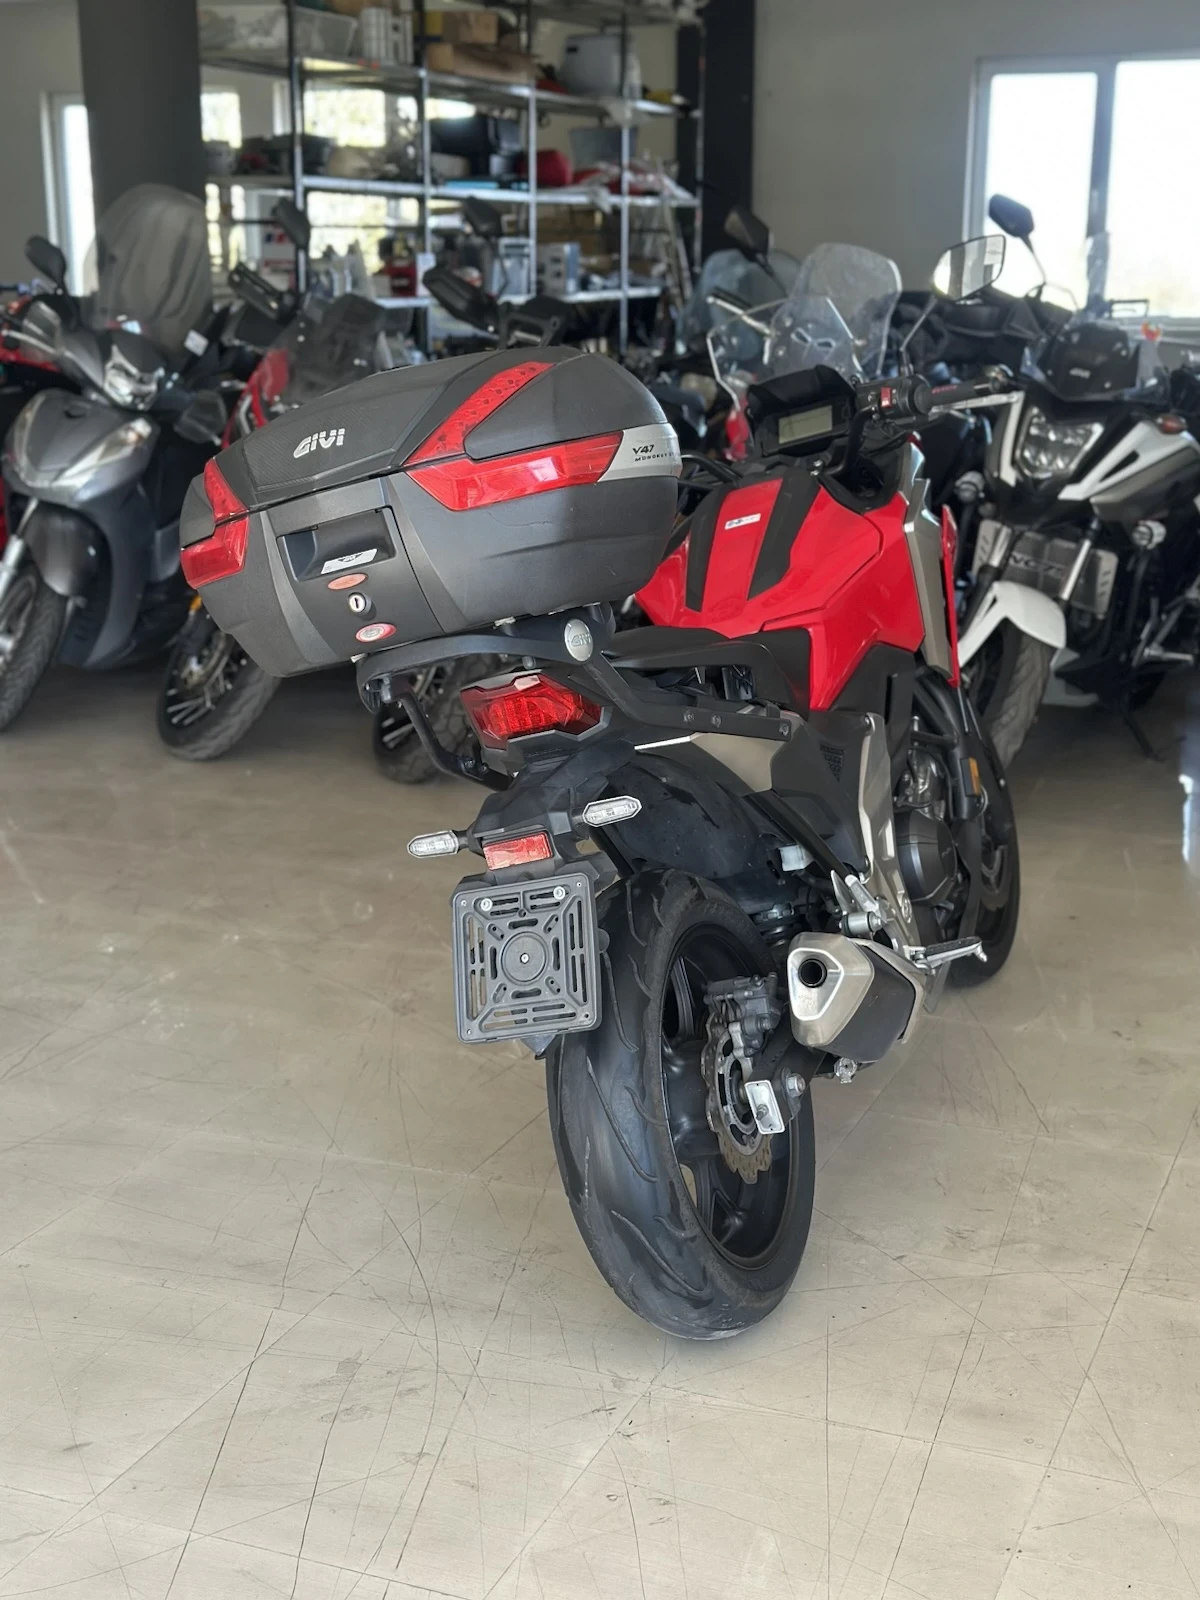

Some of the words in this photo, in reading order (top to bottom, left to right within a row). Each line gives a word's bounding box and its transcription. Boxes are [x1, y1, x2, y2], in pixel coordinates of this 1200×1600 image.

[293, 427, 345, 459] GIVI
[632, 444, 655, 455] V47
[570, 633, 592, 647] GIVI
